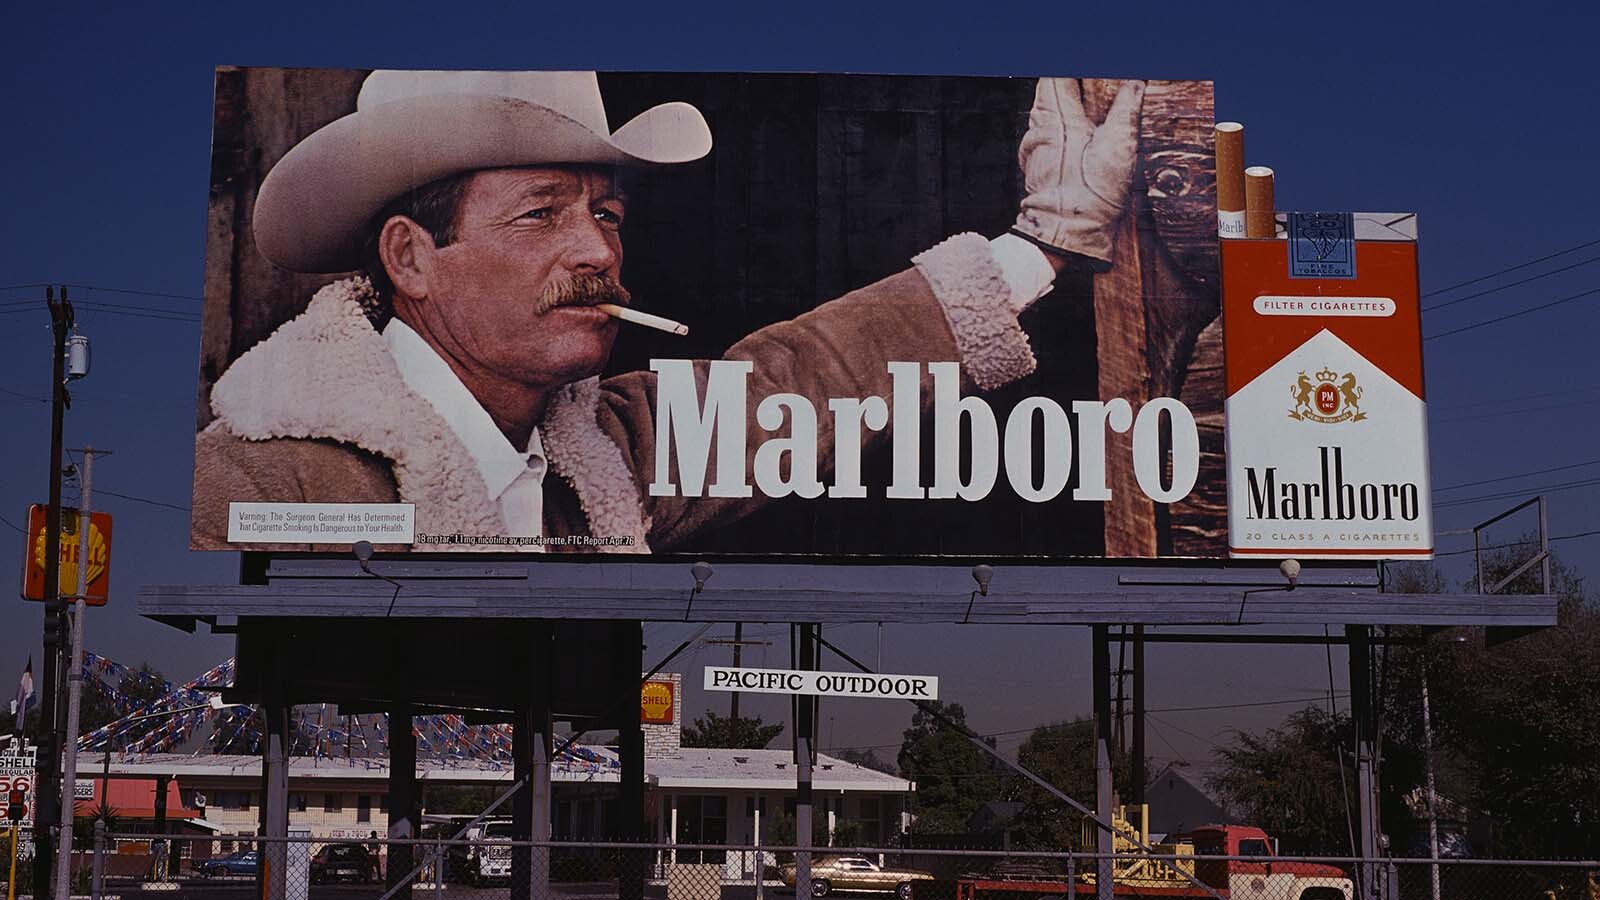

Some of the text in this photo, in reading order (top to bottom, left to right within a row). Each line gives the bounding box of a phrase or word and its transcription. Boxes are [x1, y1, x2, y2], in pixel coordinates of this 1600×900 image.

[1264, 301, 1386, 311] FILTER CIGARETTES
[1321, 391, 1334, 402] PM
[649, 358, 1200, 503] Marlboro
[1244, 446, 1419, 521] Marlboro
[271, 511, 284, 521] The
[286, 512, 316, 523] Surgeon
[318, 512, 346, 522] General
[348, 513, 361, 521] Has
[365, 513, 406, 522] Determined
[252, 522, 283, 533] Cigarette
[284, 523, 312, 533] Smoking
[313, 523, 320, 532] Is
[321, 523, 357, 534] Dangerous
[357, 524, 366, 532] to
[366, 524, 381, 532] Your
[417, 534, 427, 544] 18
[478, 535, 508, 545] nicotine
[519, 537, 532, 546] per
[568, 535, 583, 545] FTC
[584, 535, 608, 546] Report
[1246, 533, 1262, 541] 20
[1271, 533, 1315, 541] CLASS
[713, 670, 929, 696] PACIFIC OUTDOOR
[643, 696, 668, 705] SHELL
[0, 758, 37, 767] SHELL
[0, 769, 34, 777] REGULAR
[0, 776, 30, 792] 56
